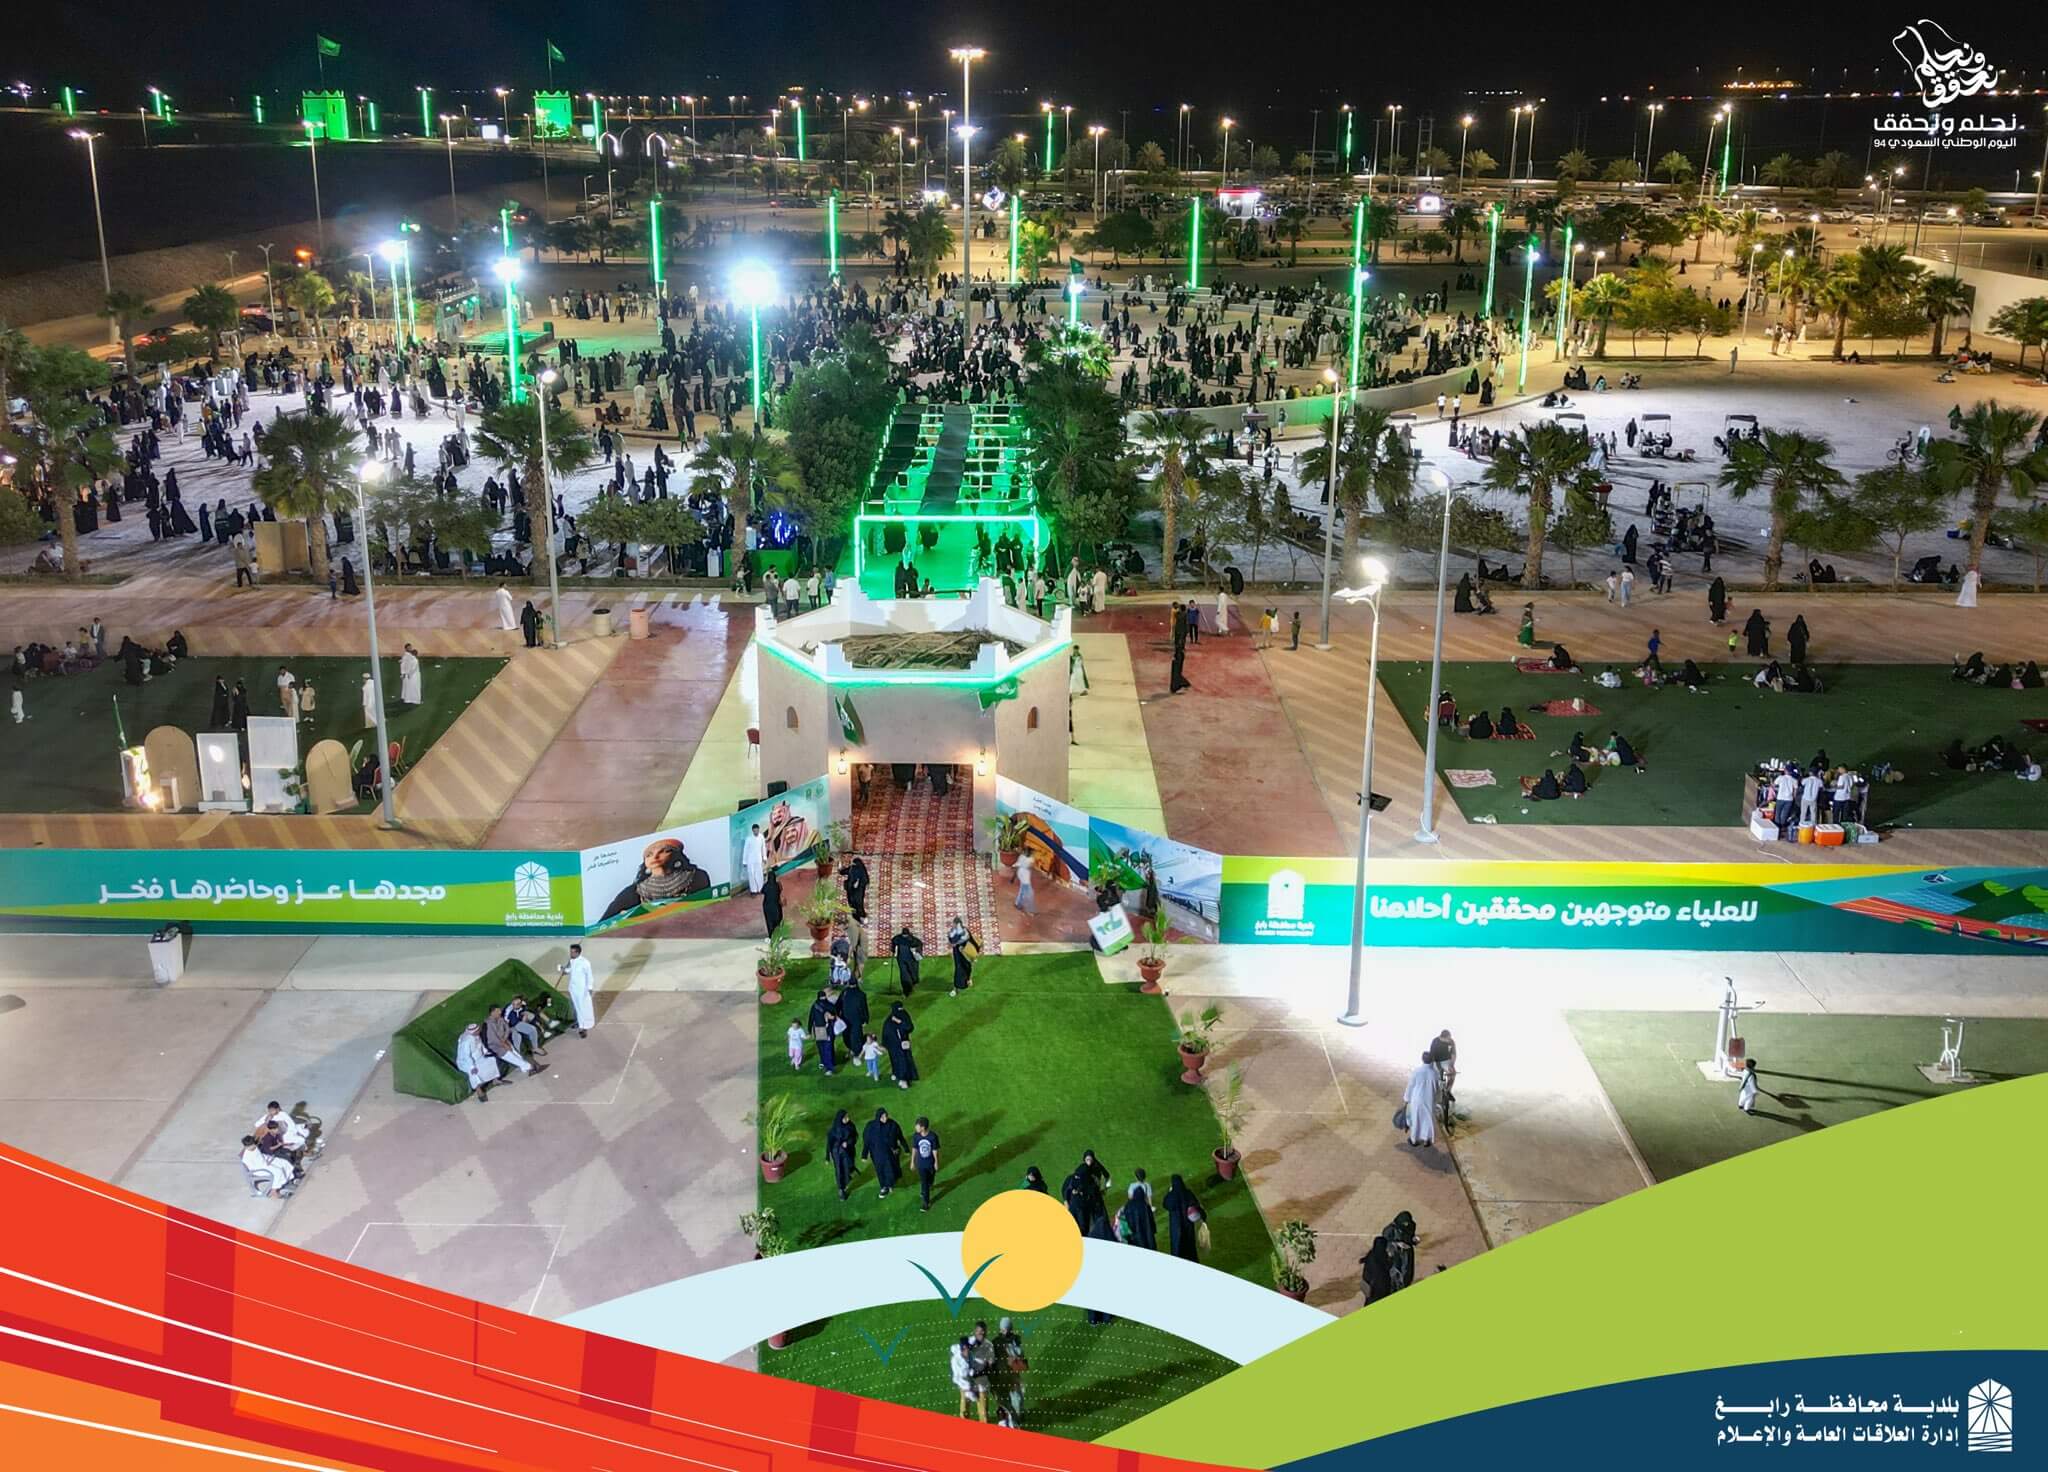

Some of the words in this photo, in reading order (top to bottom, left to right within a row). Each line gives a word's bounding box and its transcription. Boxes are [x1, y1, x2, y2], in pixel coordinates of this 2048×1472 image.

[99, 877, 164, 904] فخر
[170, 878, 289, 905] وحاضرها
[294, 878, 343, 905] عز
[349, 879, 447, 906] مجدها
[1370, 892, 1451, 920] أحلامنا
[1455, 896, 1556, 926] محققين
[1560, 901, 1671, 927] متوجهين
[1675, 899, 1758, 928] للعلياء
